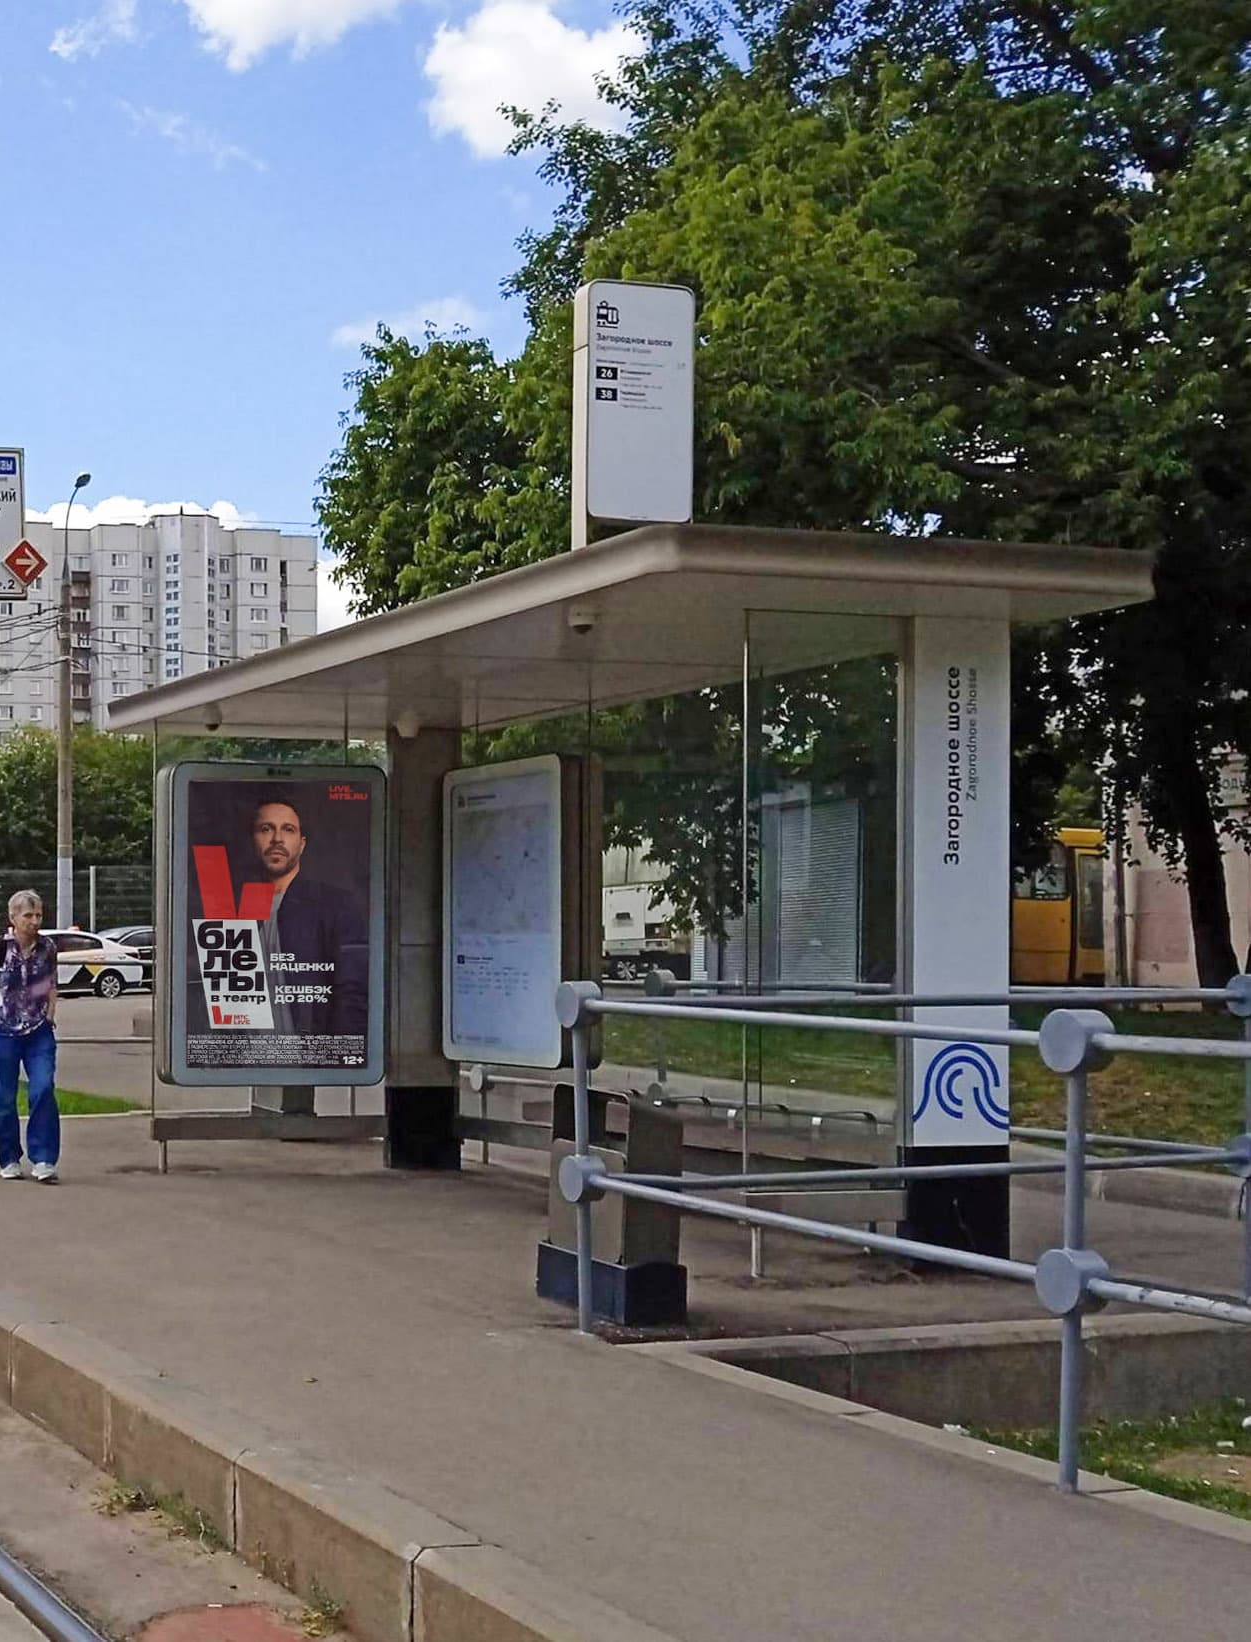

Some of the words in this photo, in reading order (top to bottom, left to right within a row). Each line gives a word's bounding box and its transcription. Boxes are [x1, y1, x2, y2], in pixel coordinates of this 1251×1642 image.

[601, 368, 613, 378] 26
[600, 389, 612, 399] 38
[967, 668, 977, 715] Shosse
[948, 666, 960, 732] шоссе
[966, 719, 979, 801] Zagorodnoe
[944, 738, 963, 865] Загородное
[197, 920, 252, 949] би
[203, 950, 257, 971] ле
[269, 953, 295, 962] БЕЗ
[269, 962, 335, 972] НАЦЕНКИ
[203, 971, 264, 991] ты
[275, 985, 332, 994] КЕШБЭК
[223, 994, 266, 1004] театр
[274, 995, 294, 1004] ДО
[297, 994, 328, 1003] 20%
[342, 1056, 364, 1064] 12+
